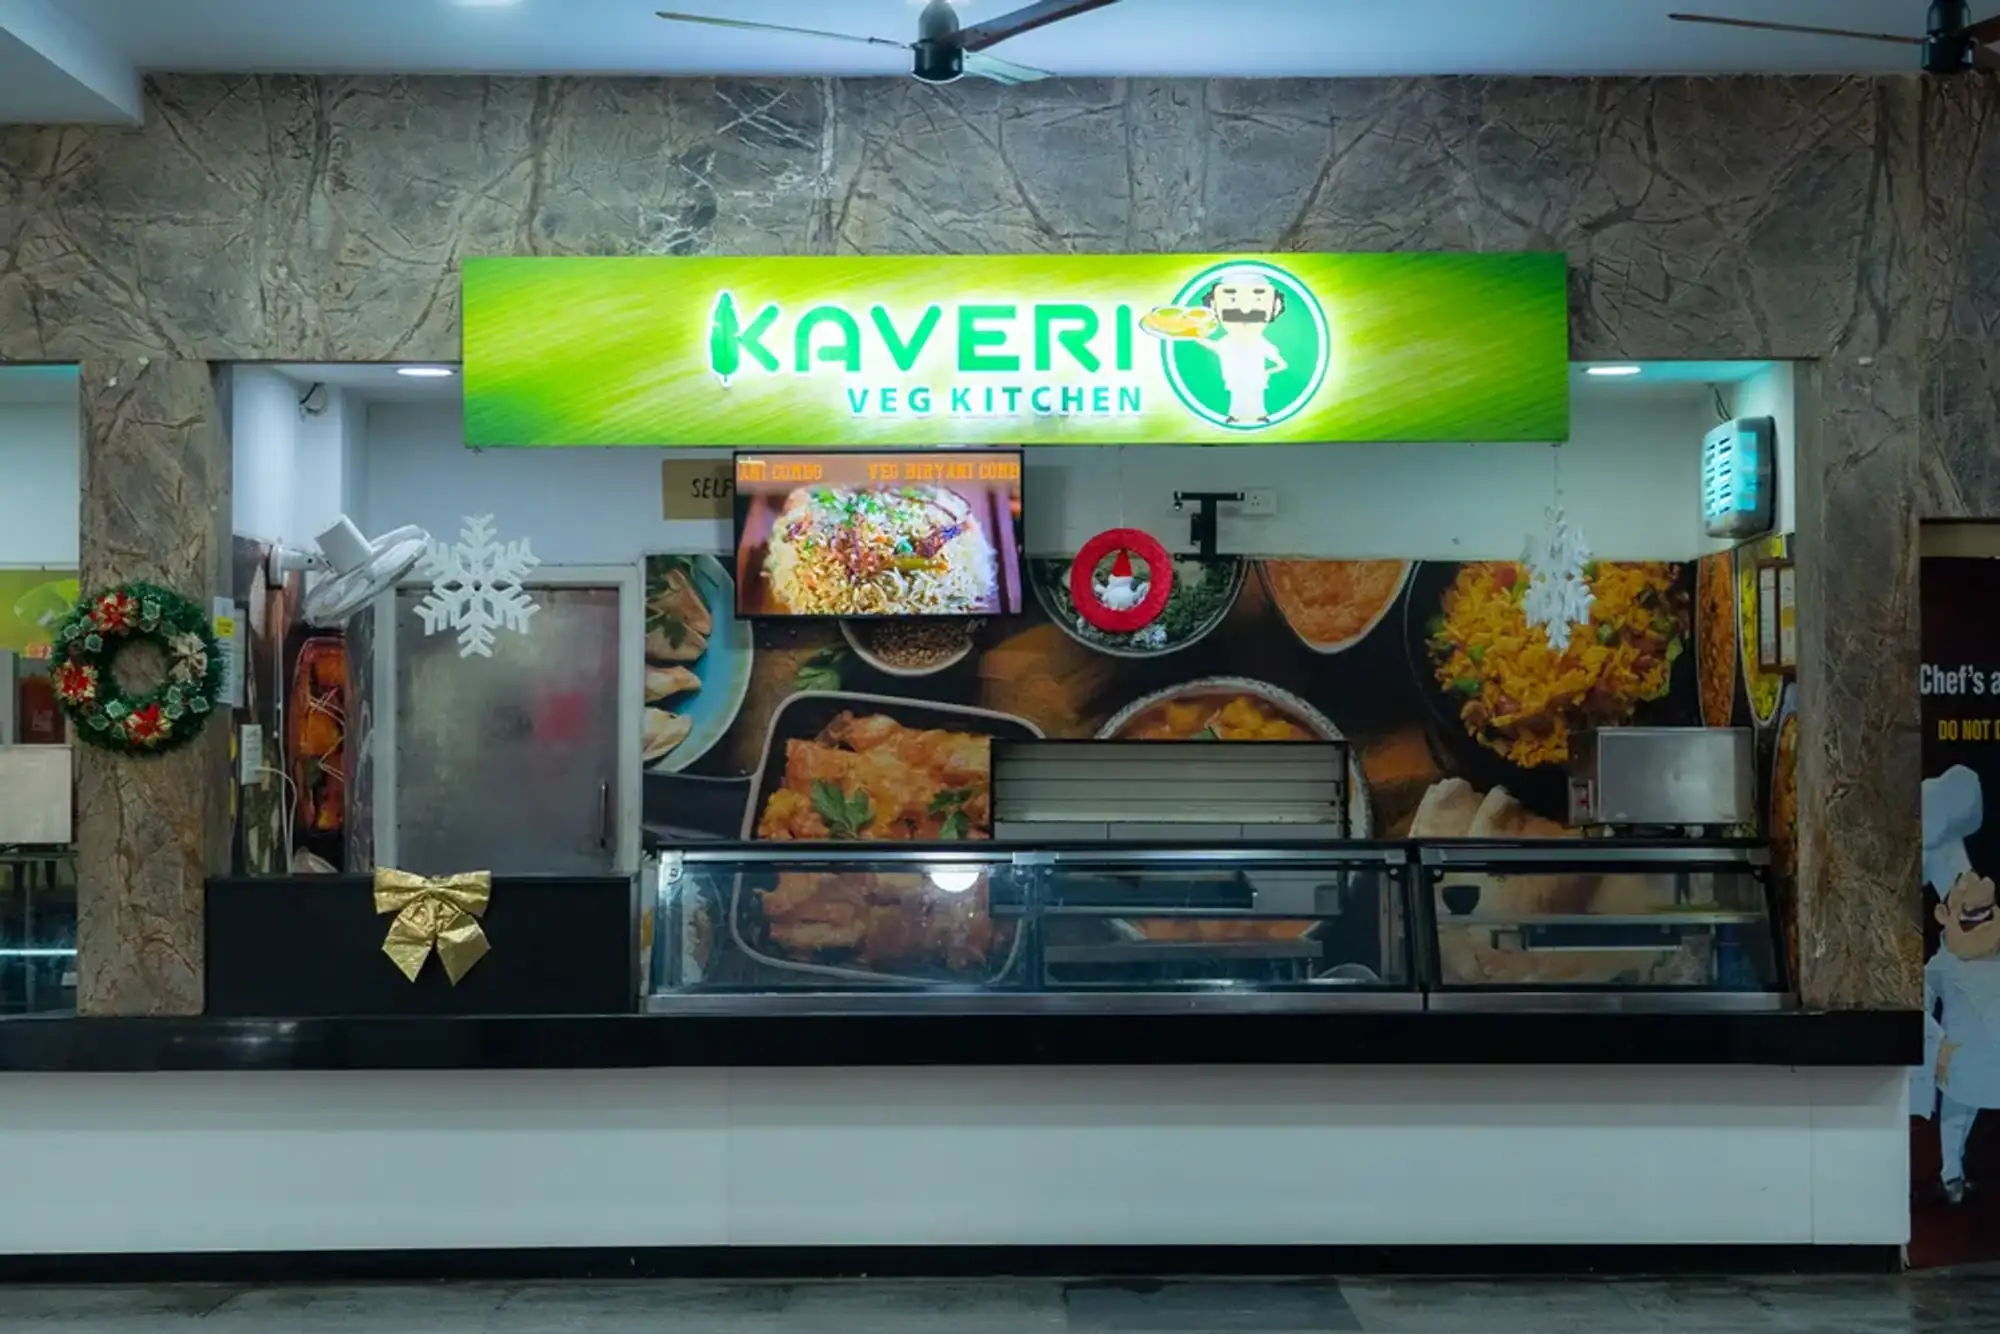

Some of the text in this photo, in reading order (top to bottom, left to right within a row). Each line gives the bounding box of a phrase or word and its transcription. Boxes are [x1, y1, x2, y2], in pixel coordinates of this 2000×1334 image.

[711, 291, 1132, 382] KAVERI
[847, 386, 1142, 413] VEG KITCHEN
[868, 463, 898, 480] VEG
[691, 477, 733, 499] SELF
[1920, 663, 1985, 695] Chef's
[1938, 719, 1958, 741] DO
[1962, 719, 1992, 741] NOT
